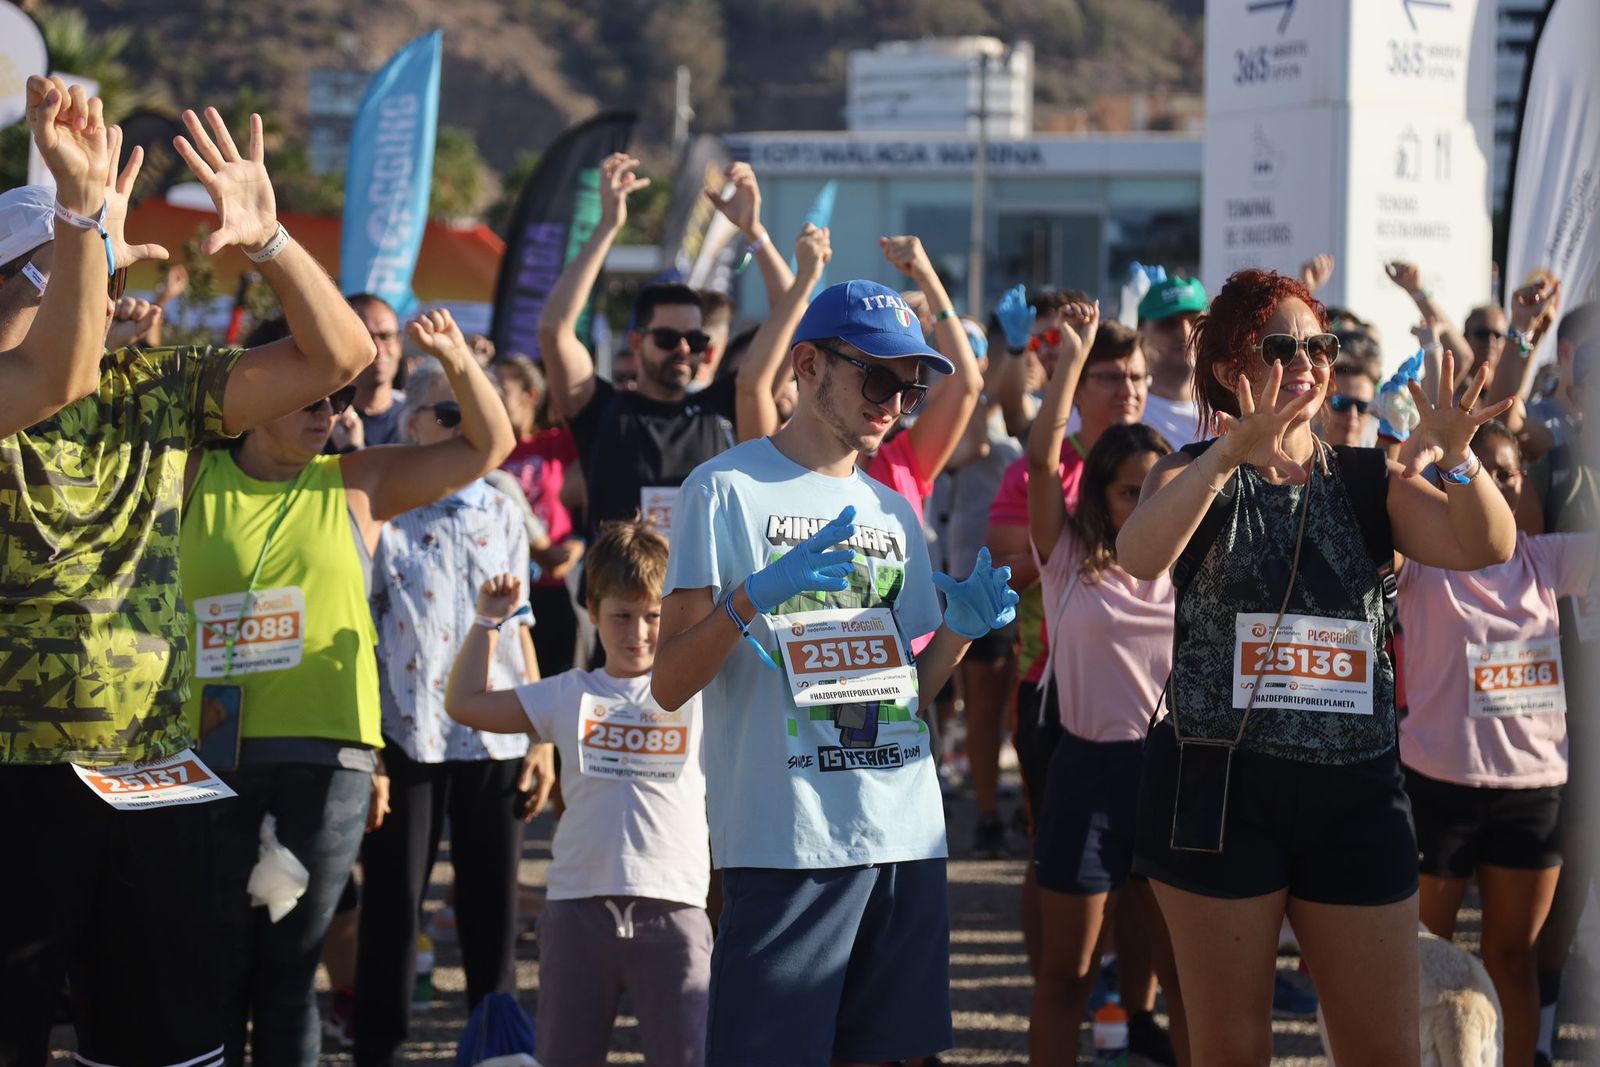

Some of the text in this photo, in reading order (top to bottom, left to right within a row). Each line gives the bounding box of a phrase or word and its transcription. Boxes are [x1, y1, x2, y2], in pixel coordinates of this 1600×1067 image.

[208, 615, 295, 646] 25088
[801, 640, 888, 669] 25135
[1254, 647, 1353, 678] 25136
[1481, 663, 1553, 690] 24386
[810, 687, 901, 701] #HAZDEPORTEPORELPLANETA
[1254, 694, 1355, 708] HAZDEPORTEPORELPLANETA
[588, 724, 682, 752] 25089
[787, 755, 814, 769] SINCE
[820, 749, 842, 768] 15
[844, 746, 902, 766] YEARS
[102, 766, 189, 793] 25137
